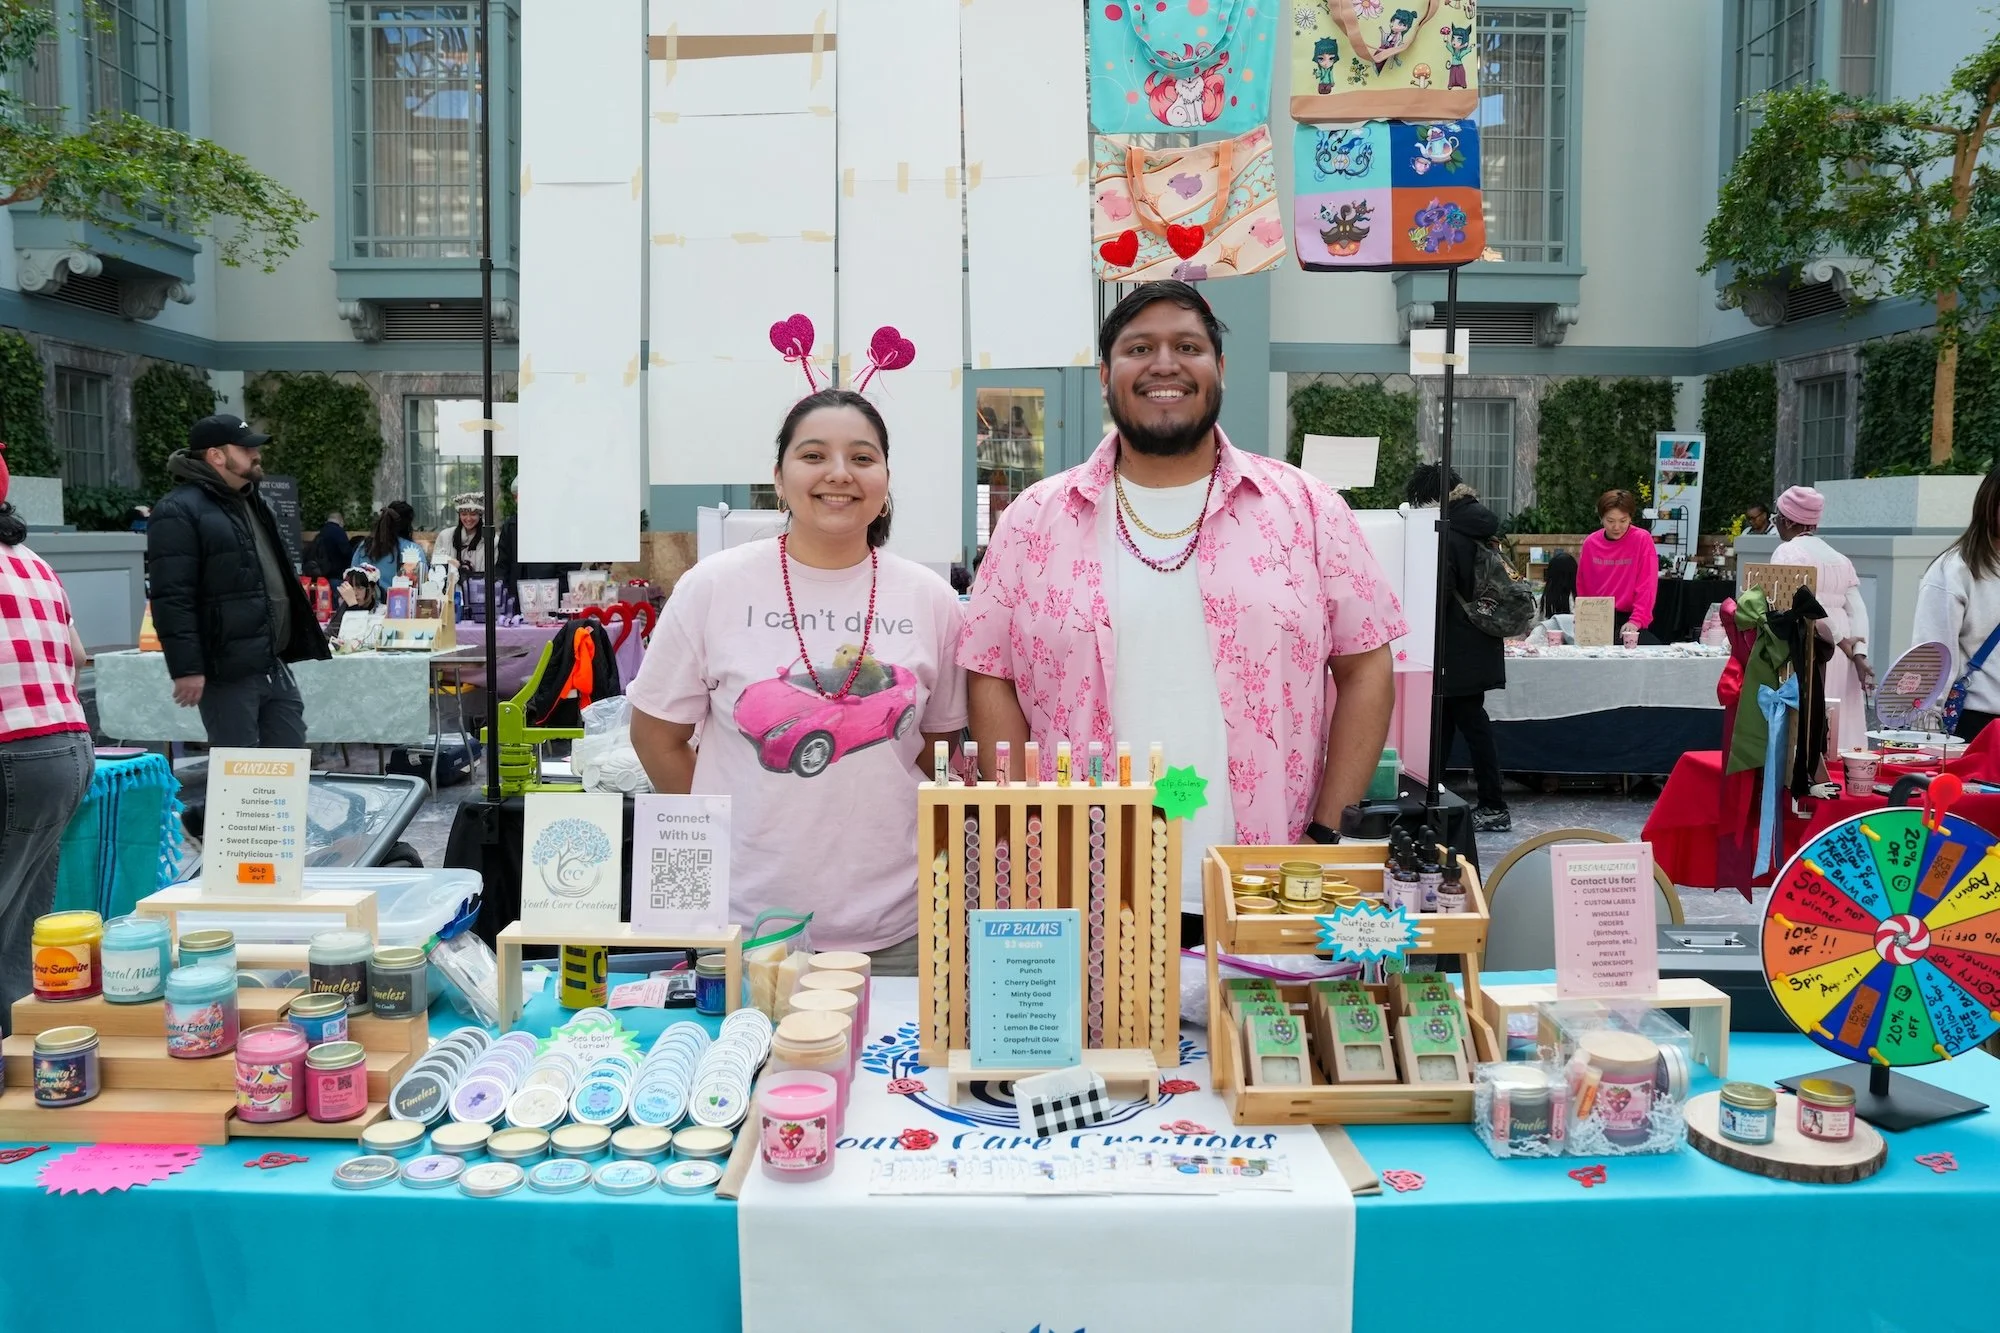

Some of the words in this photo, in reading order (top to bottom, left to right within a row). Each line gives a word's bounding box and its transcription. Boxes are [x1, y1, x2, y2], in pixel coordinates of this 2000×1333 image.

[747, 606, 752, 627] I
[765, 609, 835, 631] can't
[232, 763, 288, 775] CANDLES
[657, 813, 710, 824] Connect
[659, 830, 688, 840] With
[692, 831, 706, 841] Us
[226, 850, 273, 859] Fruitylicious
[1887, 841, 1900, 866] OFF
[1903, 827, 1920, 868] 20%
[1568, 862, 1636, 872] PERSONALIZATION
[1979, 882, 2000, 903] pin
[523, 899, 549, 909] Youth
[551, 900, 573, 909] Care
[575, 899, 618, 910] Creations
[990, 923, 1010, 936] LIP
[1014, 923, 1059, 935] BALMS
[1341, 917, 1375, 928] Cuticle
[1789, 945, 1812, 955] OFF
[50, 963, 88, 974] Sunrise
[132, 968, 159, 979] Mist
[312, 978, 361, 993] Timeless
[1789, 973, 1823, 991] Spin
[1886, 1010, 1904, 1046] 20%
[1908, 1016, 1920, 1038] OFF
[1959, 1012, 1980, 1041] FREE
[400, 1086, 437, 1110] Timeless
[953, 1131, 1052, 1150] Care
